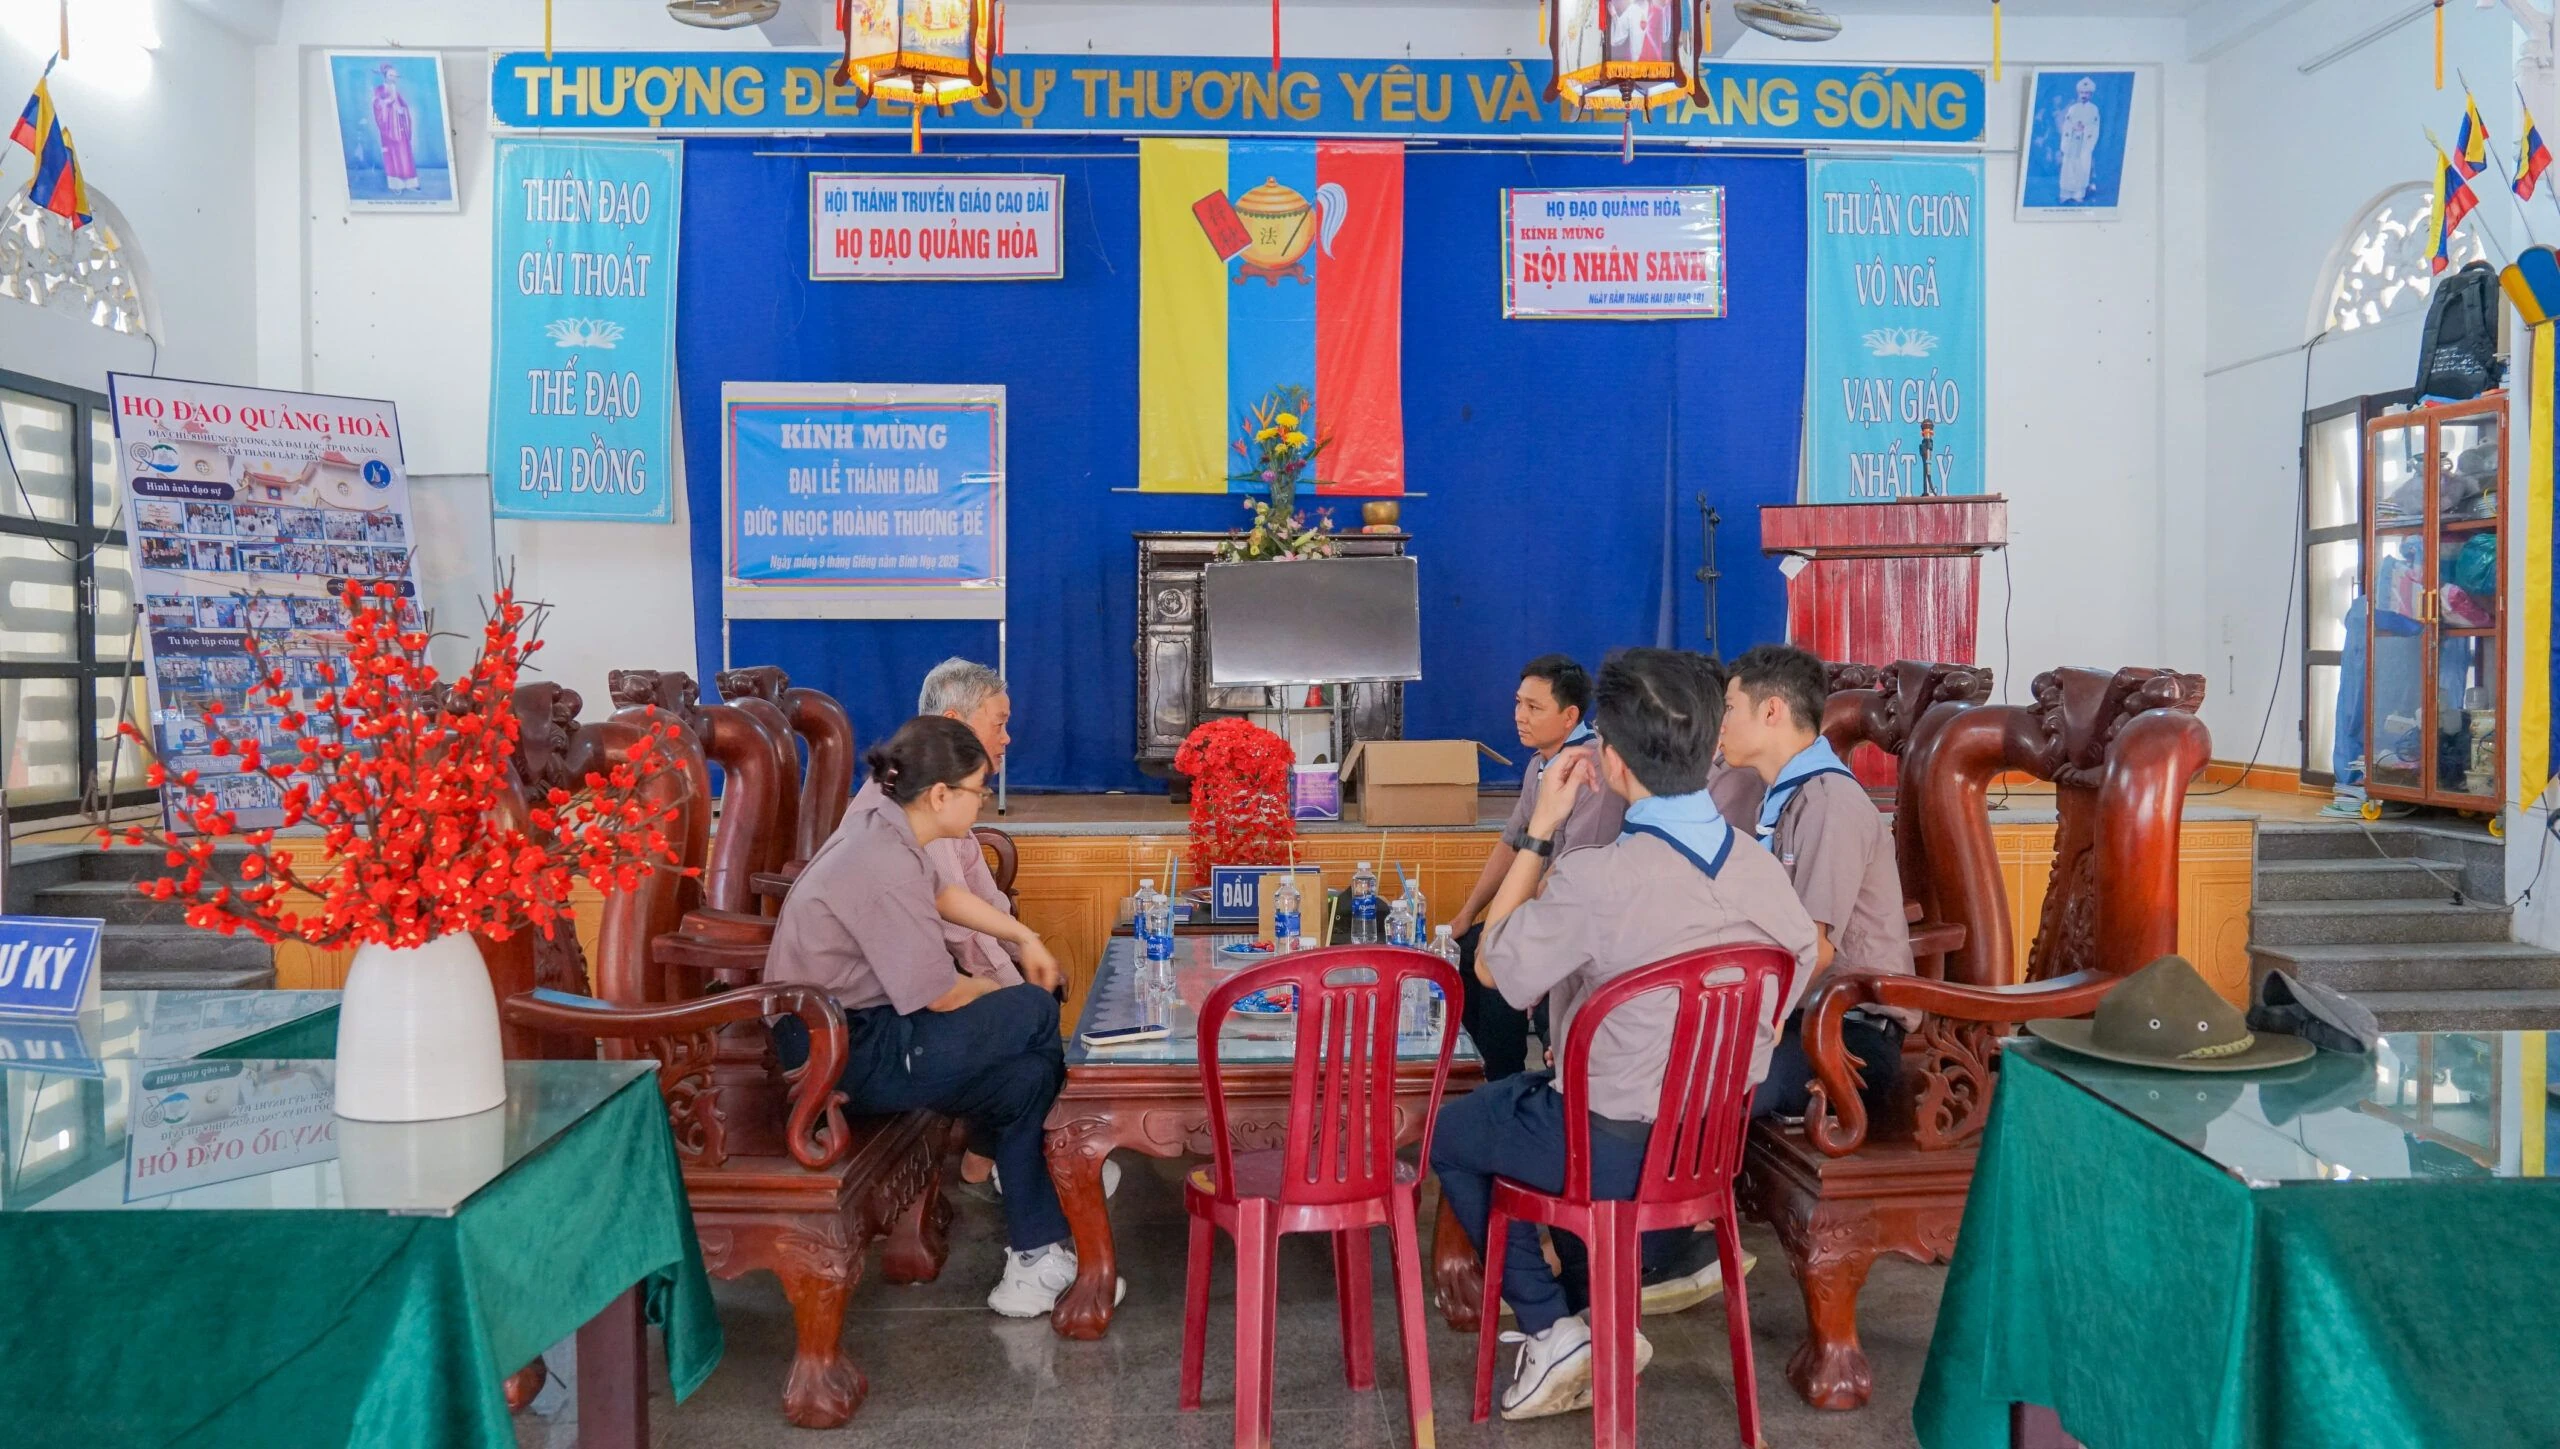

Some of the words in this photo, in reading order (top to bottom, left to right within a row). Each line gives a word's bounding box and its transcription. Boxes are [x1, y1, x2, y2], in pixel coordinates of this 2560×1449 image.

[514, 66, 764, 127] THƯỢNG
[1073, 68, 1320, 121] THƯƠNG
[1340, 64, 1451, 122] YÊU
[1467, 61, 1542, 123] VÀ
[1814, 68, 1967, 131] SỐNG
[522, 168, 593, 223] THIÊN
[599, 181, 651, 230] ĐẠO
[825, 187, 847, 217] HỘI
[852, 187, 898, 213] THÁNH
[959, 187, 990, 213] GIÁO
[996, 191, 1022, 213] CAO
[1027, 187, 1049, 213] ĐÀI
[1547, 200, 1565, 220] HỌ
[1570, 201, 1597, 220] ĐẠO
[1602, 196, 1648, 218] QUẢNG
[1824, 179, 1901, 236] THUẦN
[1907, 193, 1970, 237] CHƠN
[836, 228, 862, 265] HỌ
[870, 228, 911, 265] ĐẠO
[919, 218, 989, 262] QUẢNG
[1260, 227, 1278, 246] 法
[1521, 226, 1557, 240] KÍNH
[1562, 224, 1605, 240] MỪNG
[517, 239, 563, 296] GIẢI
[571, 242, 651, 297] THOÁT
[1523, 246, 1567, 290] HỘI
[1573, 245, 1638, 282] NHÂN
[1646, 252, 1707, 282] SANH
[1855, 254, 1887, 307] VÔ
[1894, 257, 1941, 308] NGÃ
[527, 354, 578, 416] THẾ
[585, 371, 641, 424] ĐẠO
[1842, 378, 1893, 429] VẠN
[1900, 368, 1960, 424] GIÁO
[122, 396, 164, 424] HỌ
[173, 401, 231, 430] ĐẠO
[240, 403, 330, 433] QUẢNG
[338, 413, 391, 438] HOÀ
[781, 418, 853, 449] KÍNH
[863, 418, 947, 450] MỪNG
[519, 446, 564, 499] ĐẠI
[571, 432, 646, 495] ĐỒNG
[789, 467, 817, 500] ĐẠI
[822, 459, 842, 494] LỄ
[845, 463, 899, 494] THÁNH
[1850, 439, 1917, 497] NHẤT
[744, 504, 777, 537] ĐỨC
[782, 510, 828, 542] NGỌC
[833, 505, 889, 537] HOÀNG
[893, 509, 958, 542] THƯỢNG
[963, 502, 984, 537] ĐẾ
[770, 555, 792, 570] Ngày
[819, 555, 825, 568] 9
[826, 554, 850, 570] tháng
[852, 554, 876, 570] Giêng
[878, 554, 897, 568] năm
[938, 555, 960, 569] 2026
[183, 635, 200, 648] học
[1222, 875, 1253, 907] ĐẦU
[22, 938, 77, 990] KÝ
